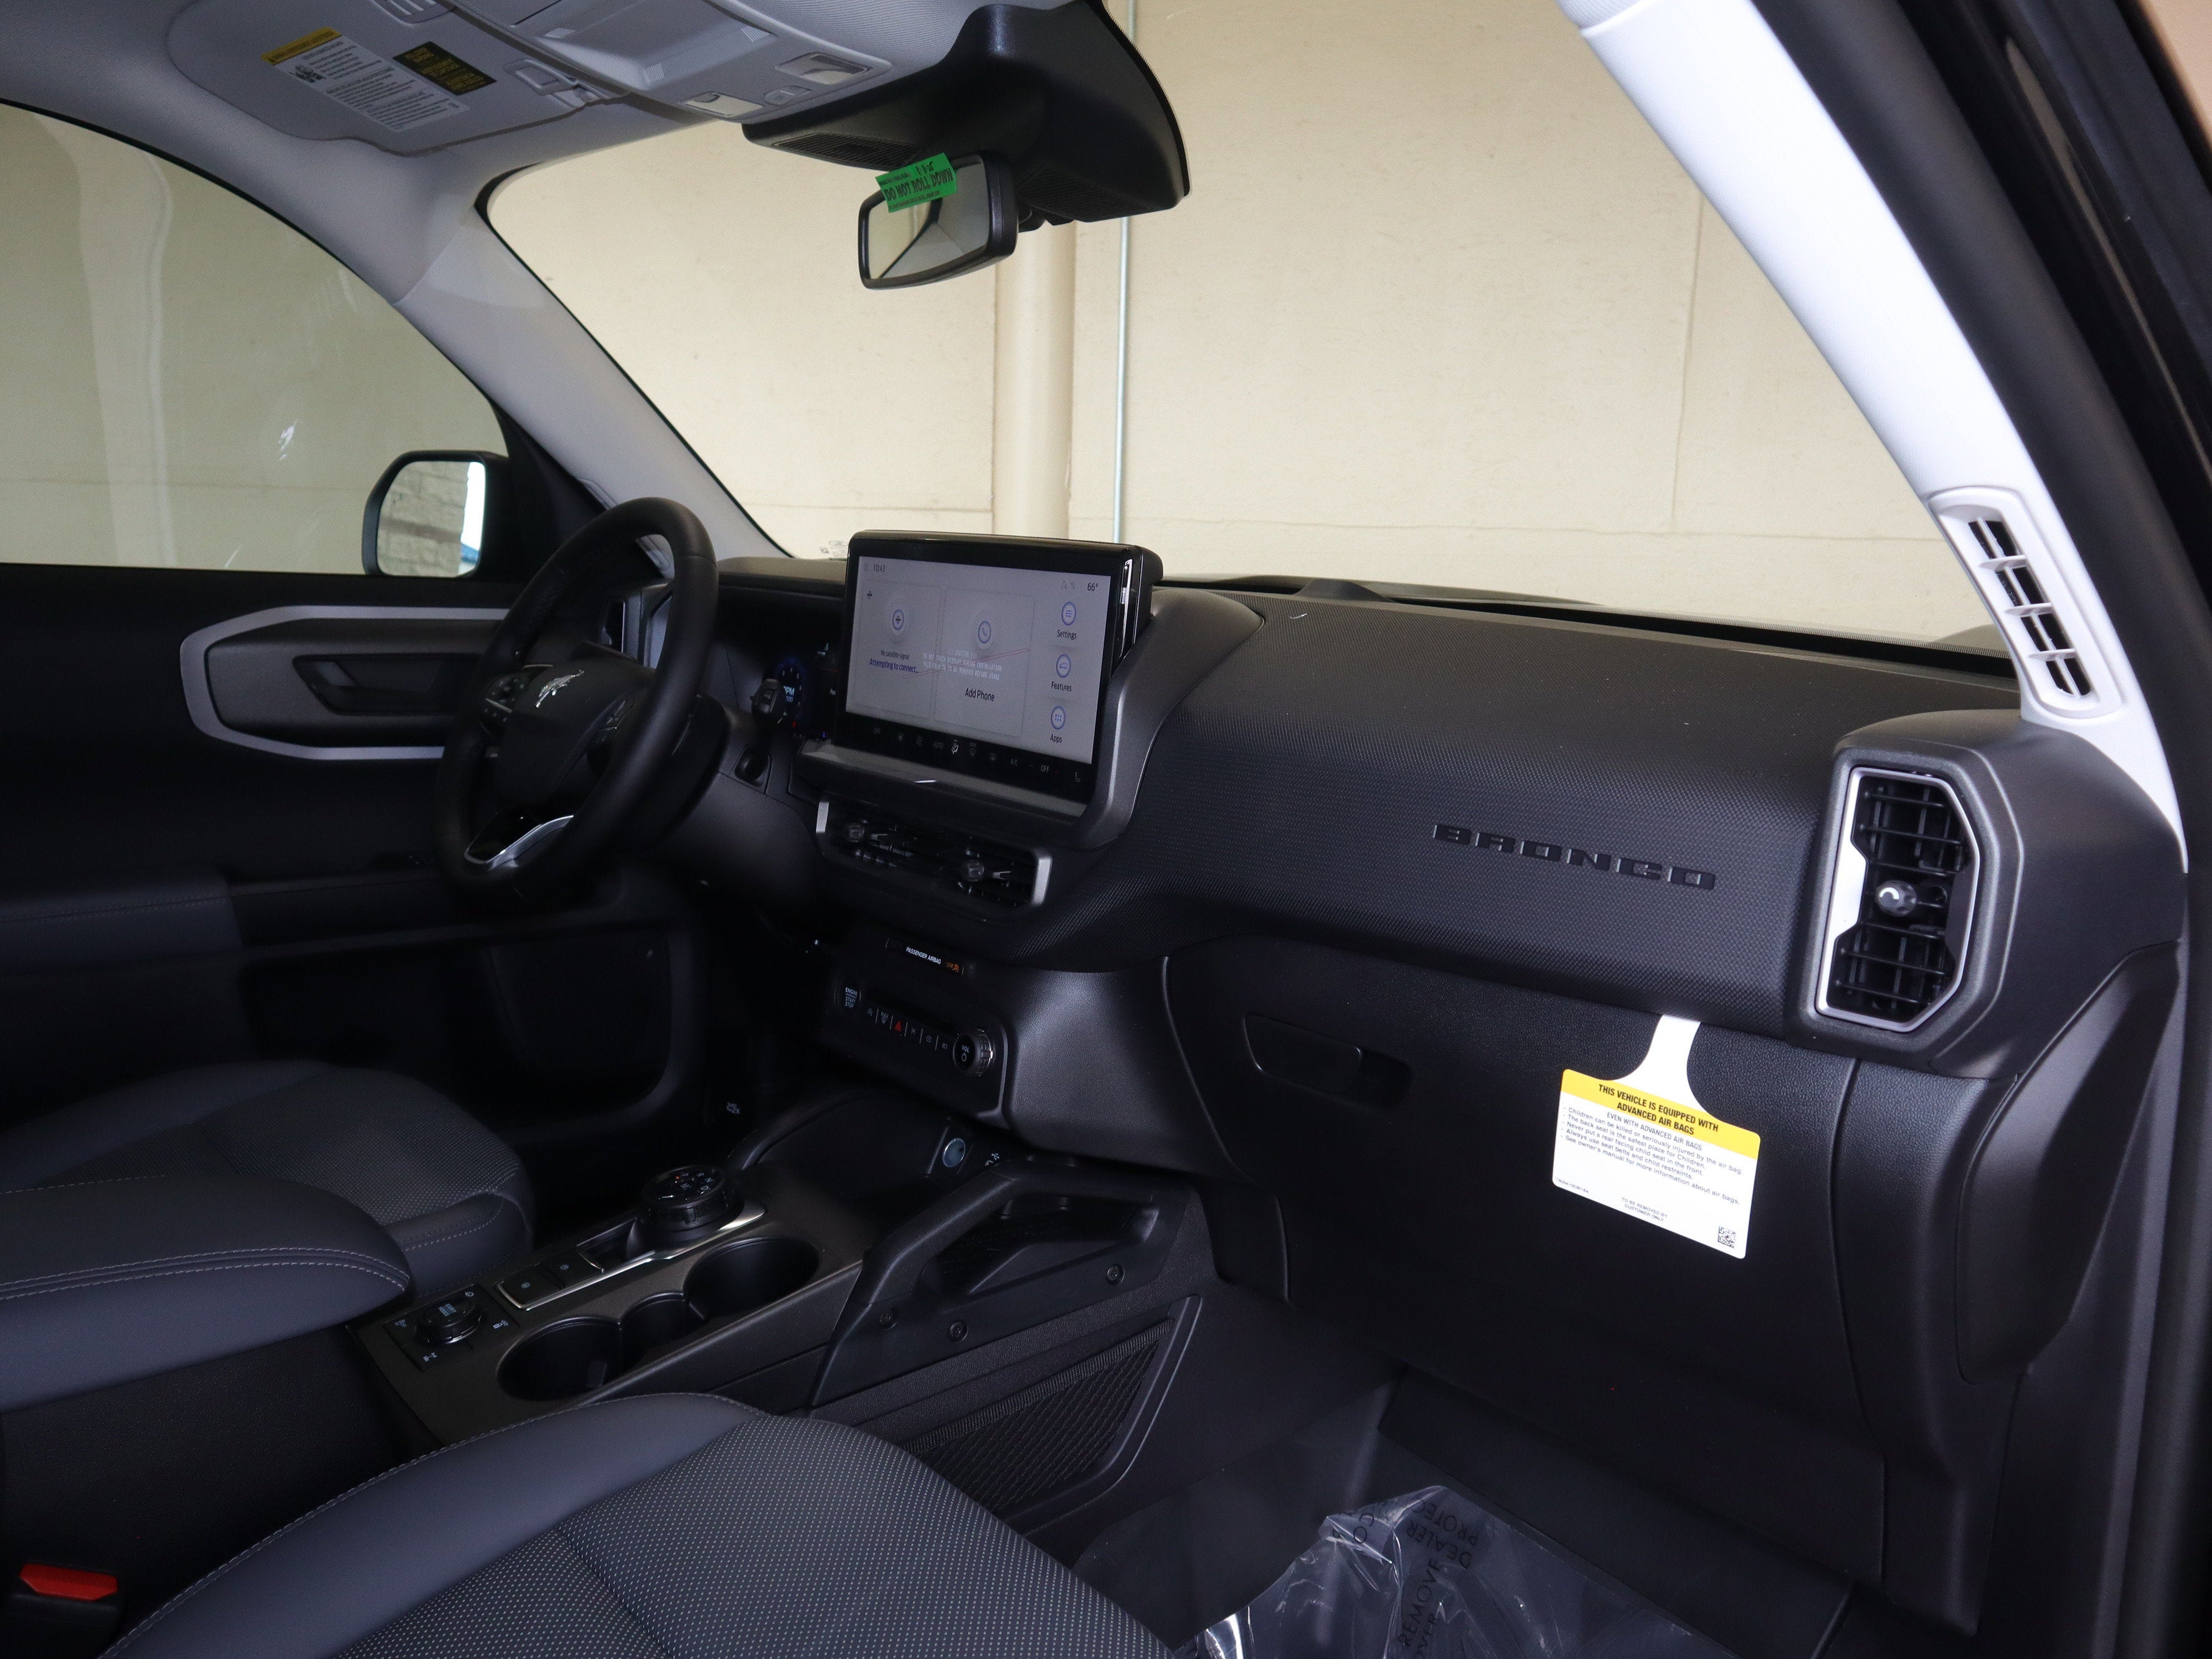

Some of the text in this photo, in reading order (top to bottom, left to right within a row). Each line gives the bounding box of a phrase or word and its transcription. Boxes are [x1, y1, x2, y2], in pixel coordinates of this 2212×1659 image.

[884, 187, 896, 201] DO
[896, 181, 911, 197] NOT
[930, 168, 953, 187] DOWN
[1057, 630, 1077, 640] Settings
[869, 658, 894, 670] Attempting
[886, 651, 899, 659] satellite
[965, 688, 995, 701] Add Phone
[1051, 681, 1072, 691] Features
[1050, 734, 1062, 743] Apps
[1041, 765, 1050, 773] OFF
[1432, 824, 1716, 890] BRONCO
[906, 947, 927, 959] PASSENGER
[927, 955, 942, 964] AIRBAG
[845, 987, 858, 996] ENGINE
[1599, 1084, 1719, 1132] THIS VEHICLE IS EQUIPPED WITH
[1617, 1102, 1694, 1135] ADVANCED AIR BAGS
[1569, 1107, 1593, 1120] Children
[1617, 1125, 1632, 1135] killed
[1642, 1134, 1671, 1149] seriously
[1673, 1143, 1694, 1157] injured
[1697, 1153, 1704, 1161] by
[1706, 1157, 1717, 1165] the
[1729, 1165, 1743, 1175] bag.
[1581, 1118, 1594, 1128] back
[1596, 1125, 1608, 1133] seat
[1628, 1137, 1647, 1147] safest
[1648, 1143, 1665, 1153] place
[1678, 1153, 1706, 1169] Children.
[1607, 1112, 1702, 1151] EVEN WITH ADVANCED AIR BAGS
[1566, 1128, 1587, 1140] Always
[1601, 1141, 1614, 1150] seat
[1615, 1146, 1630, 1156] belts
[1645, 1158, 1660, 1167] child
[1662, 1164, 1693, 1179] restraints.
[1567, 1122, 1584, 1131] Never
[1615, 1138, 1634, 1151] facing
[1635, 1147, 1650, 1156] child
[1653, 1153, 1665, 1161] seat
[1686, 1165, 1704, 1176] front.
[1566, 1135, 1577, 1143] See
[1578, 1141, 1601, 1153] owner's
[1602, 1151, 1625, 1161] manual
[1637, 1163, 1652, 1171] more
[1654, 1169, 1690, 1186] information
[1692, 1183, 1710, 1193] about
[1722, 1193, 1740, 1205] bags.
[1625, 1204, 1650, 1217] CUSTOMER
[1637, 1203, 1660, 1216] REMOVED
[1407, 1524, 1473, 1569] DEALER
[1399, 1557, 1444, 1647] REMOVE
